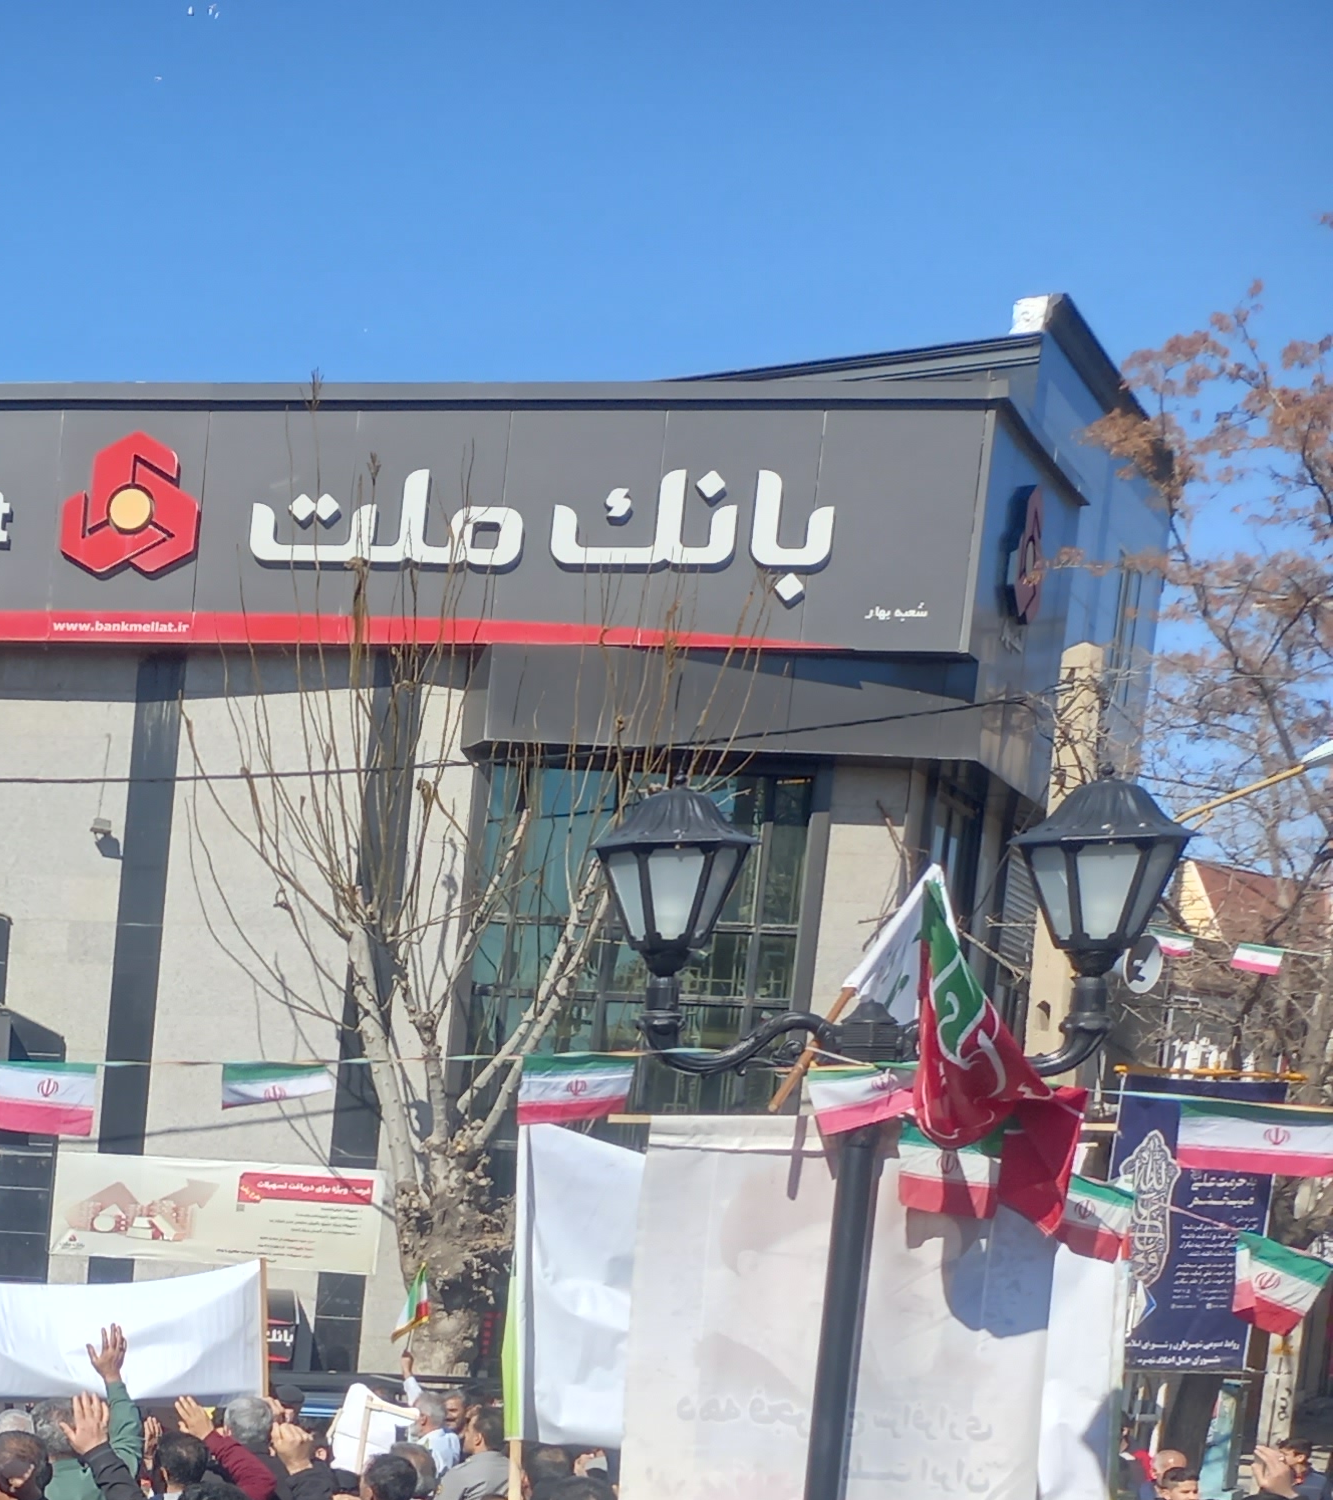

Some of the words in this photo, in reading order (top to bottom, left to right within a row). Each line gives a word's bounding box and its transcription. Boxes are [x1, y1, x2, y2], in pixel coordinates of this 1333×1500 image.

[248, 467, 524, 568] ملت
[864, 605, 891, 621] بهار
[894, 602, 929, 622] شعبه
[52, 620, 190, 633] www.bankmellat.ir
